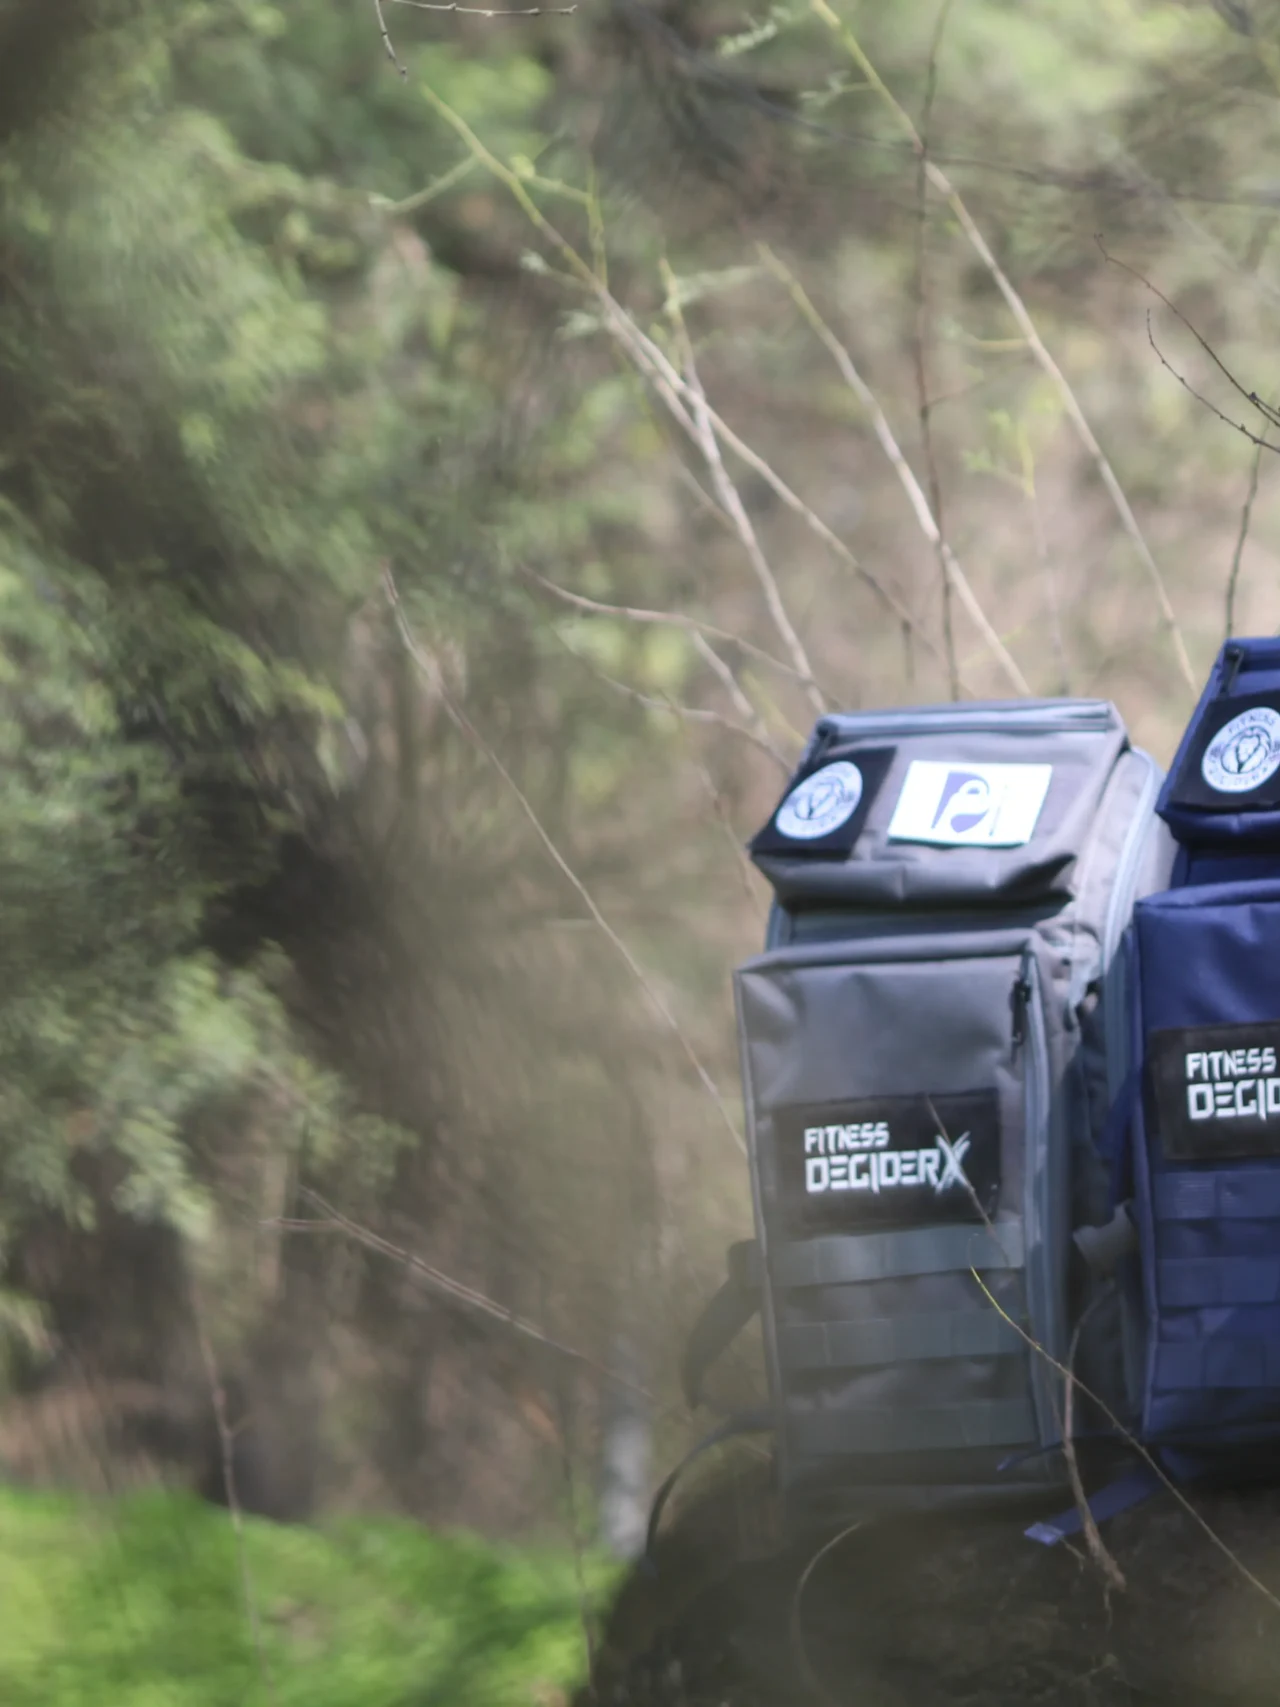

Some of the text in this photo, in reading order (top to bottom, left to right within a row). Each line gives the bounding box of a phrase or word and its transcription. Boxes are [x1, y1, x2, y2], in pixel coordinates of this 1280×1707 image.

[1186, 1047, 1276, 1080] FITNESS
[804, 1122, 890, 1155] FITNESS
[805, 1131, 970, 1194] DECIDERX
